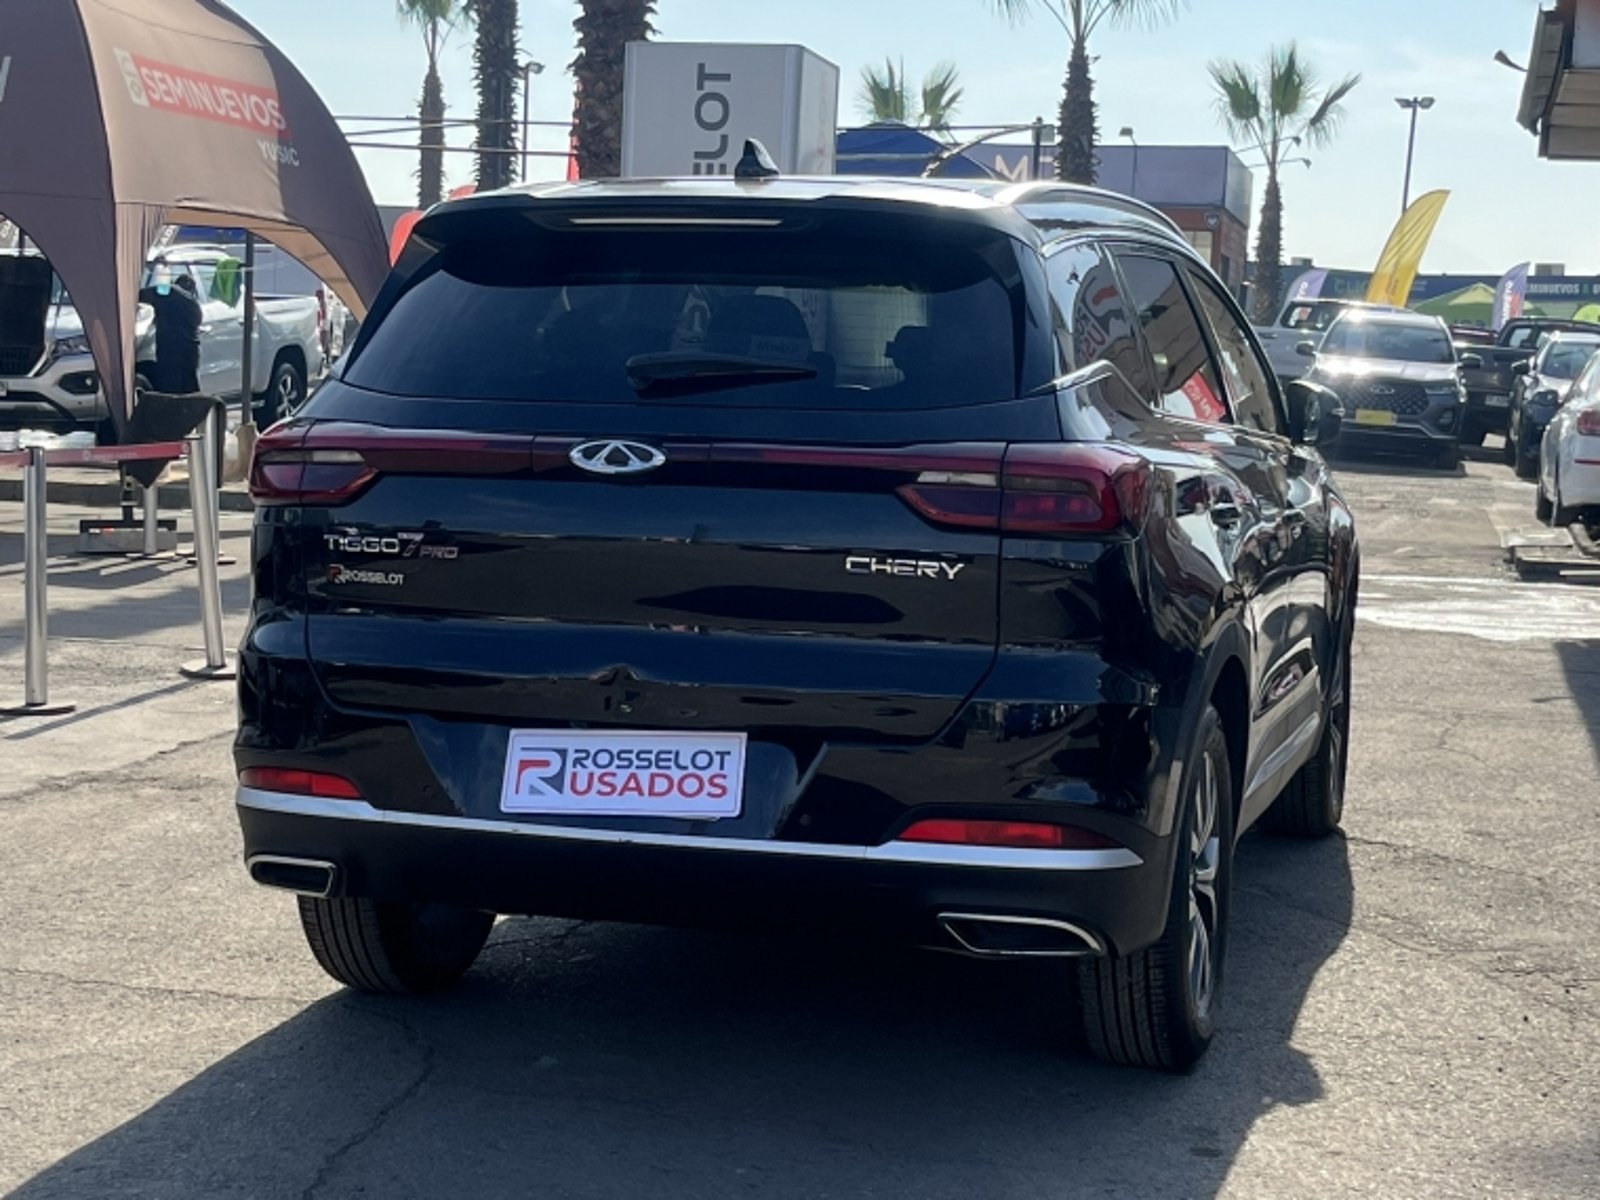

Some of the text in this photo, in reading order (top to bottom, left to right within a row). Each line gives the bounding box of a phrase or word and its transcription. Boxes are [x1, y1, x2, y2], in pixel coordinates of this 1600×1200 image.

[139, 65, 287, 131] SEMINUEVOS
[1526, 283, 1580, 295] MINUEVOS
[419, 546, 459, 559] PRO
[343, 569, 404, 585] ROSSELOT
[845, 556, 965, 580] CHERY
[571, 749, 731, 771] ROSSELOT
[570, 771, 728, 799] USADOS
